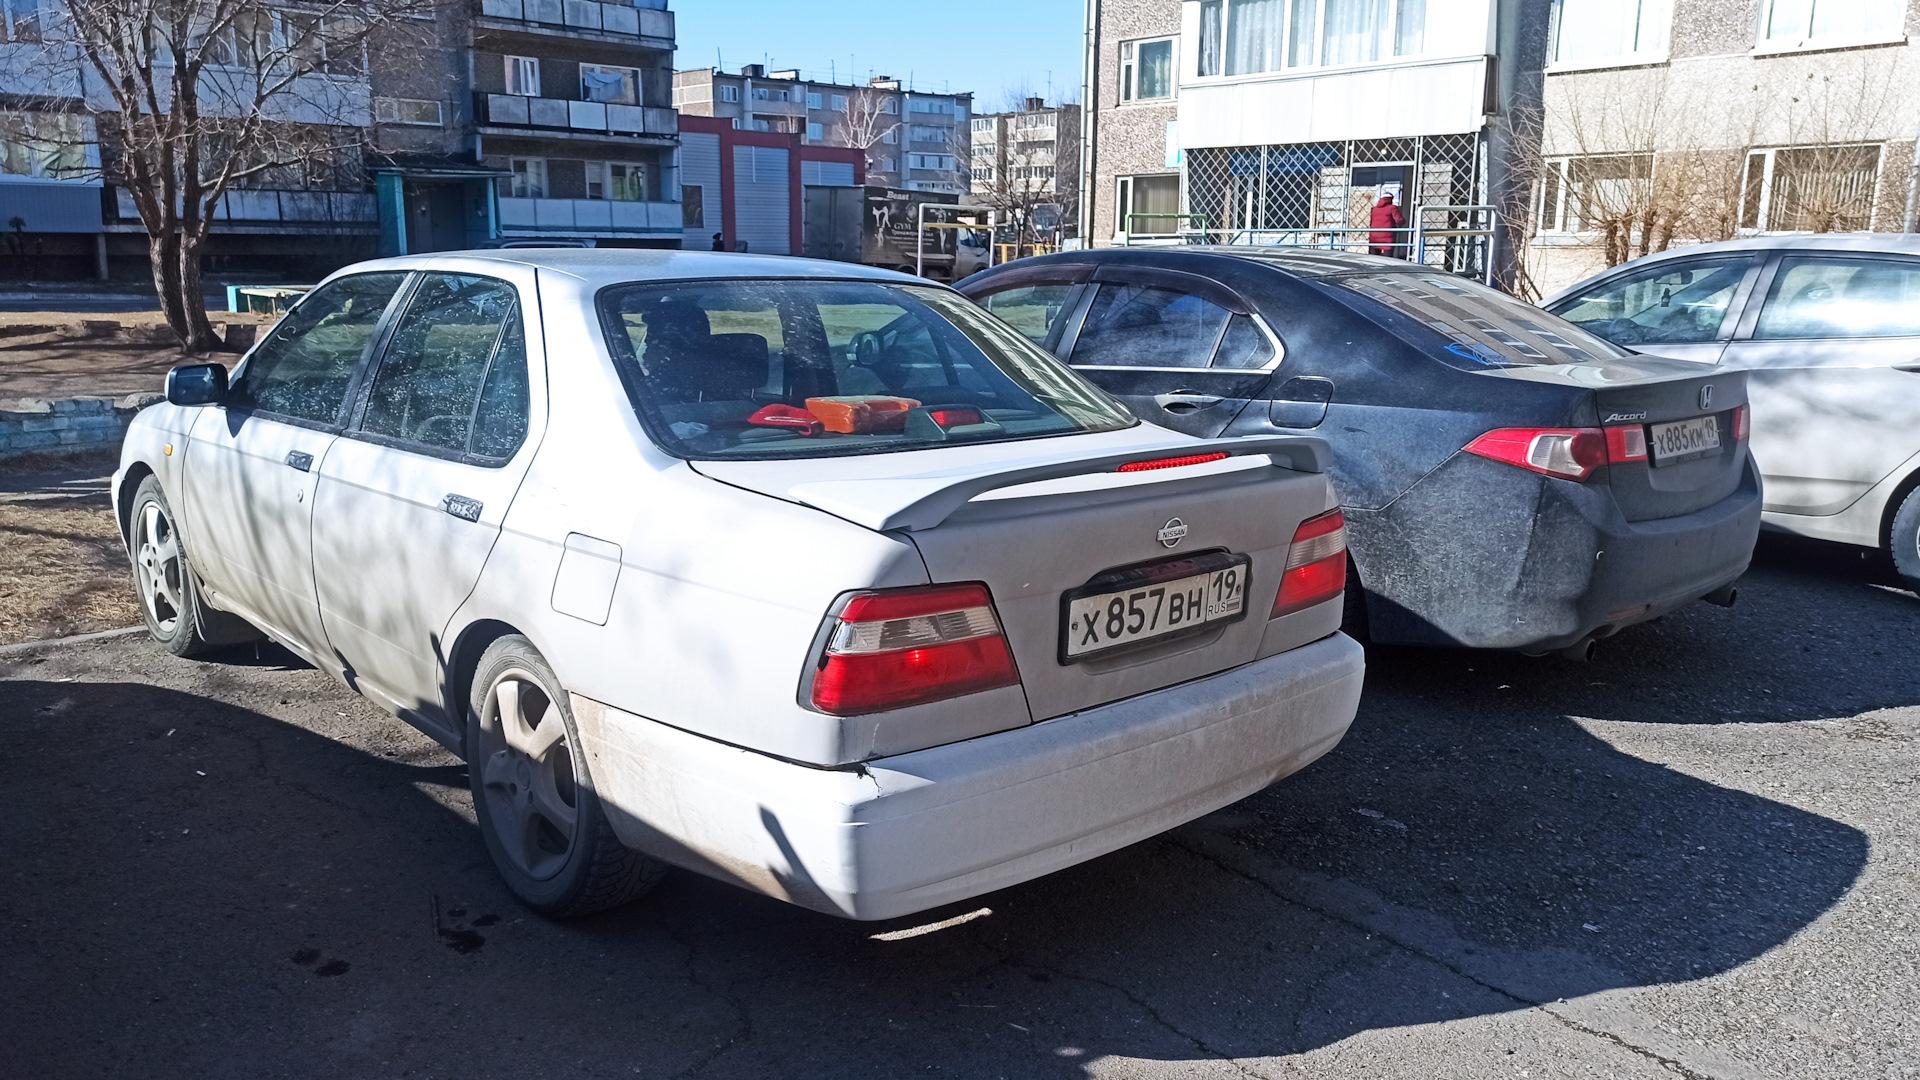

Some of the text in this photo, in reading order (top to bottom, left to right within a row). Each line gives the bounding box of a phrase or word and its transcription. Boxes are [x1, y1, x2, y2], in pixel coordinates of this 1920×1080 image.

[1604, 411, 1647, 423] Accord
[1704, 418, 1715, 438] 19
[1162, 527, 1186, 539] NISSAN
[1081, 569, 1237, 646] Х857ВН 19
[1207, 602, 1226, 616] RUS
